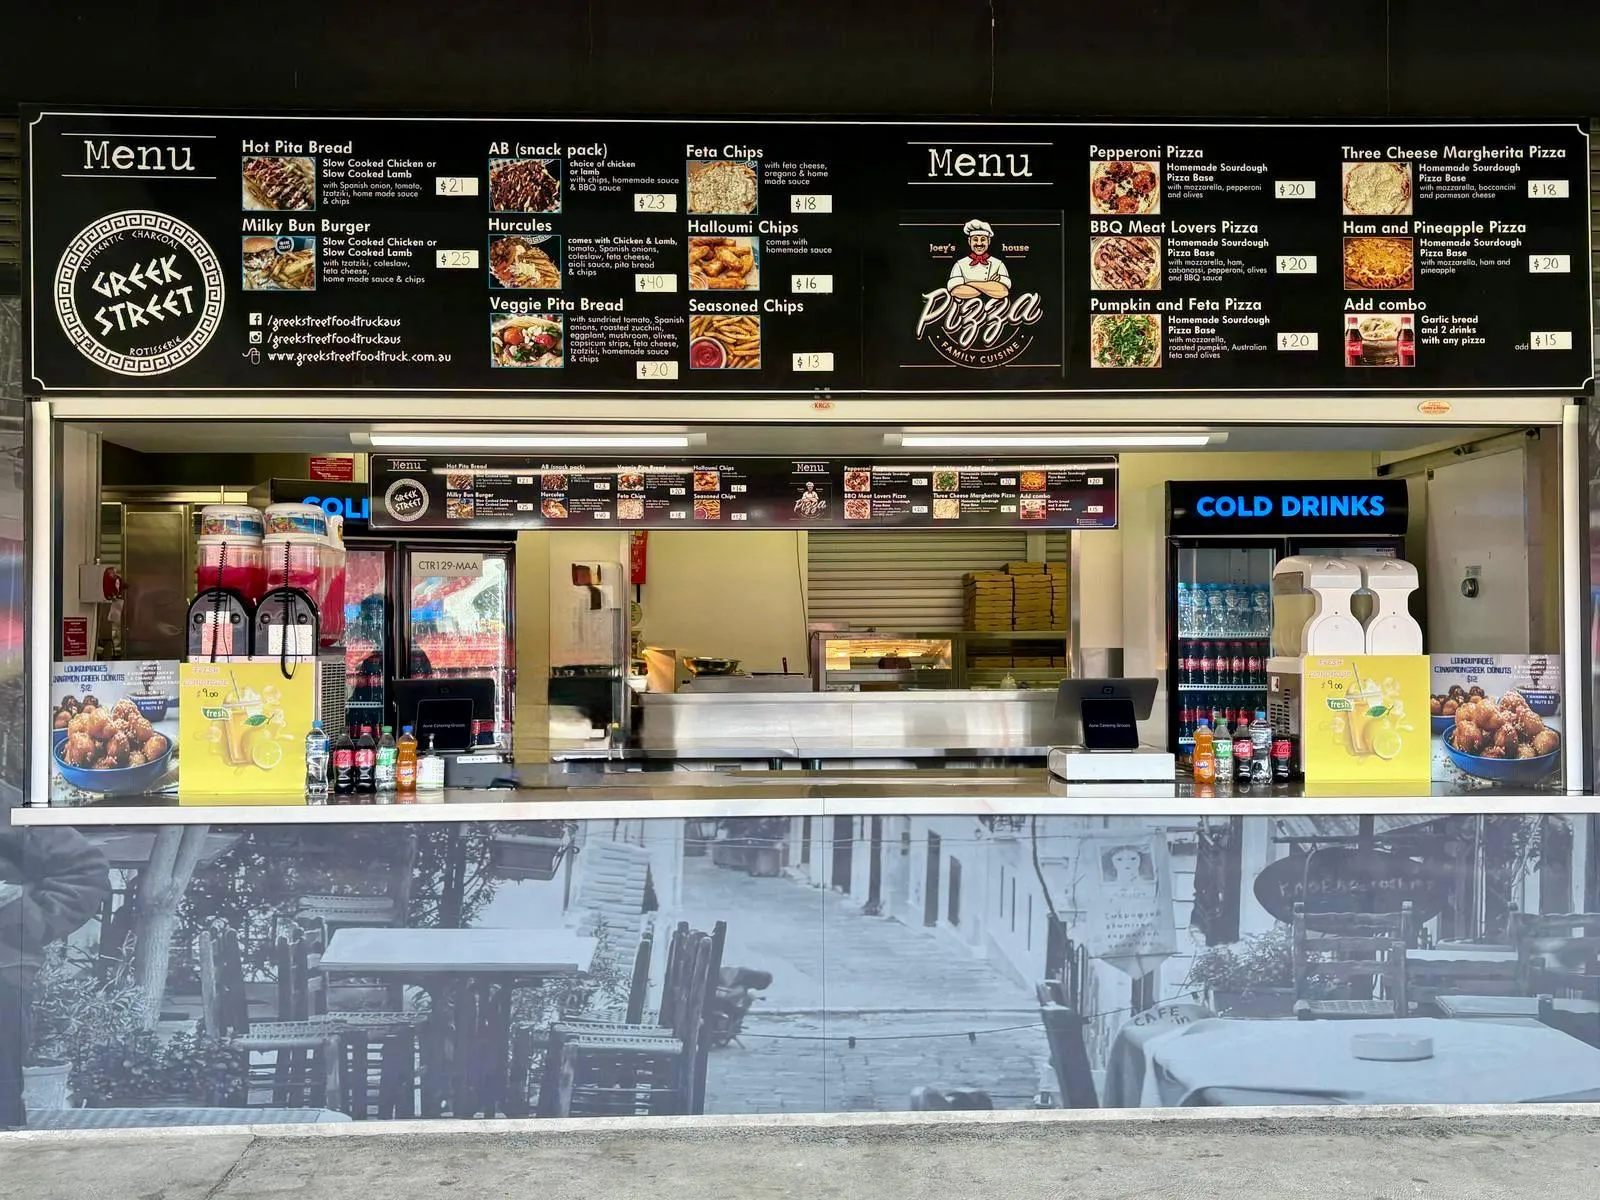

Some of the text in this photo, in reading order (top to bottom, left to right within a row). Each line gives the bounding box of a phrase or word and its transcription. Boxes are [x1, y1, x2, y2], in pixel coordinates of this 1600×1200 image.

[242, 139, 352, 154] Hot Pita Bread
[488, 142, 607, 159] AB (snack pack)
[686, 144, 763, 160] Feta Chips
[1090, 145, 1203, 160] Pepperoni Pizza
[1341, 145, 1566, 162] Three Cheese Margherita Pizza
[83, 140, 195, 171] Menu
[928, 148, 1033, 177] Menu
[323, 158, 345, 167] Slow
[348, 158, 384, 168] Cooked
[387, 159, 424, 168] Chicken
[569, 160, 636, 169] choice of chicken
[764, 161, 780, 169] with
[782, 161, 797, 169] feta
[1167, 163, 1268, 174] Homemade Sourdough
[323, 169, 412, 178] Slow Cooked Lamb
[1167, 173, 1214, 182] Pizza Base
[242, 218, 371, 235] Milky Bun Burger
[488, 218, 552, 232] Hurcules
[688, 220, 798, 236] Halloumi Chips
[1090, 220, 1258, 234] BBQ Meat Lovers Pizza
[1343, 220, 1526, 237] Ham and Pineapple Pizza
[323, 237, 345, 246] Slow
[348, 237, 384, 246] Cooked
[387, 237, 424, 246] Chicken
[594, 236, 611, 246] with
[613, 237, 644, 246] Chicken
[654, 237, 678, 246] Lamb,
[1002, 243, 1029, 251] house
[81, 230, 179, 272] AUTHENTIC CHARCOAL
[323, 247, 413, 257] Slow Cooked Lamb
[766, 246, 808, 254] homemade
[929, 243, 956, 254] Joey's
[91, 254, 183, 298] GREEK
[347, 275, 369, 283] made
[405, 275, 425, 284] chips
[94, 285, 194, 336] STREET
[490, 297, 623, 313] Veggie Pita Bread
[689, 298, 804, 315] Seasoned Chips
[1091, 297, 1261, 313] Pumpkin and Feta Pizza
[1344, 298, 1427, 311] Add combo
[267, 315, 401, 330] /greekstreetfoodtruckaus
[916, 287, 1043, 351] Pizza
[1421, 315, 1478, 324] Garlic bread
[1421, 325, 1438, 334] and
[1449, 325, 1476, 334] drinks
[129, 335, 183, 357] ROTISSERIE
[267, 332, 401, 347] /greekstreetfoodtruckaus
[1421, 336, 1440, 344] with
[1461, 335, 1485, 345] pizza
[267, 350, 451, 367] www.greekstreetfoodtruck.com.au
[941, 341, 1020, 364] FAMILY CUISINE
[392, 461, 421, 470] Menu
[797, 463, 825, 472] Menu
[394, 490, 418, 502] GREEK
[395, 498, 421, 511] STREET
[793, 499, 827, 515] Pizza
[1196, 495, 1385, 517] COLD DRINKS
[418, 560, 479, 570] CTR129-MAA
[1330, 700, 1350, 708] fresh
[206, 709, 227, 717] fresh
[1134, 1006, 1180, 1026] CAFE
